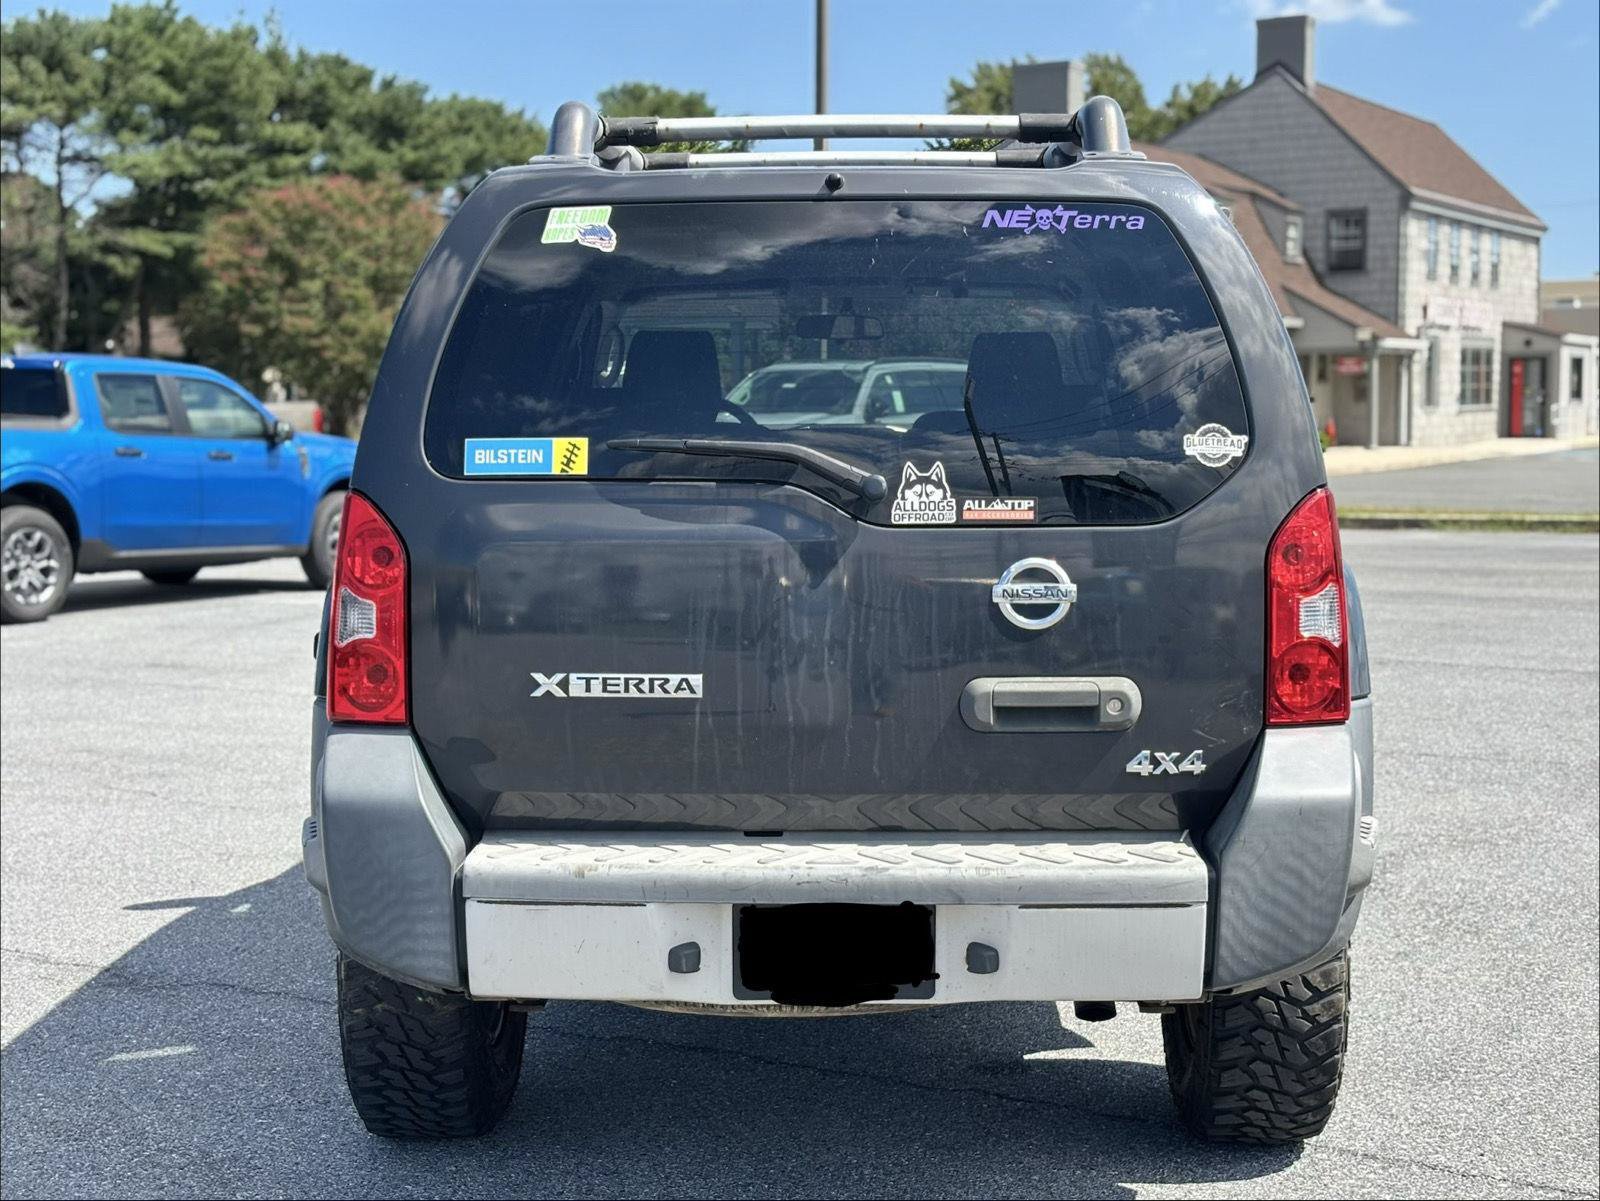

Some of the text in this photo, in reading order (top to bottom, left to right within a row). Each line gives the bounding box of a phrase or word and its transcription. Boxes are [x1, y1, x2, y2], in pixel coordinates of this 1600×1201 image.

[550, 208, 608, 224] FREEDOM
[475, 449, 543, 464] BILSTEIN
[894, 500, 954, 512] ALLDOGS
[893, 512, 945, 522] OFFROAD
[1002, 588, 1068, 599] NISSAN
